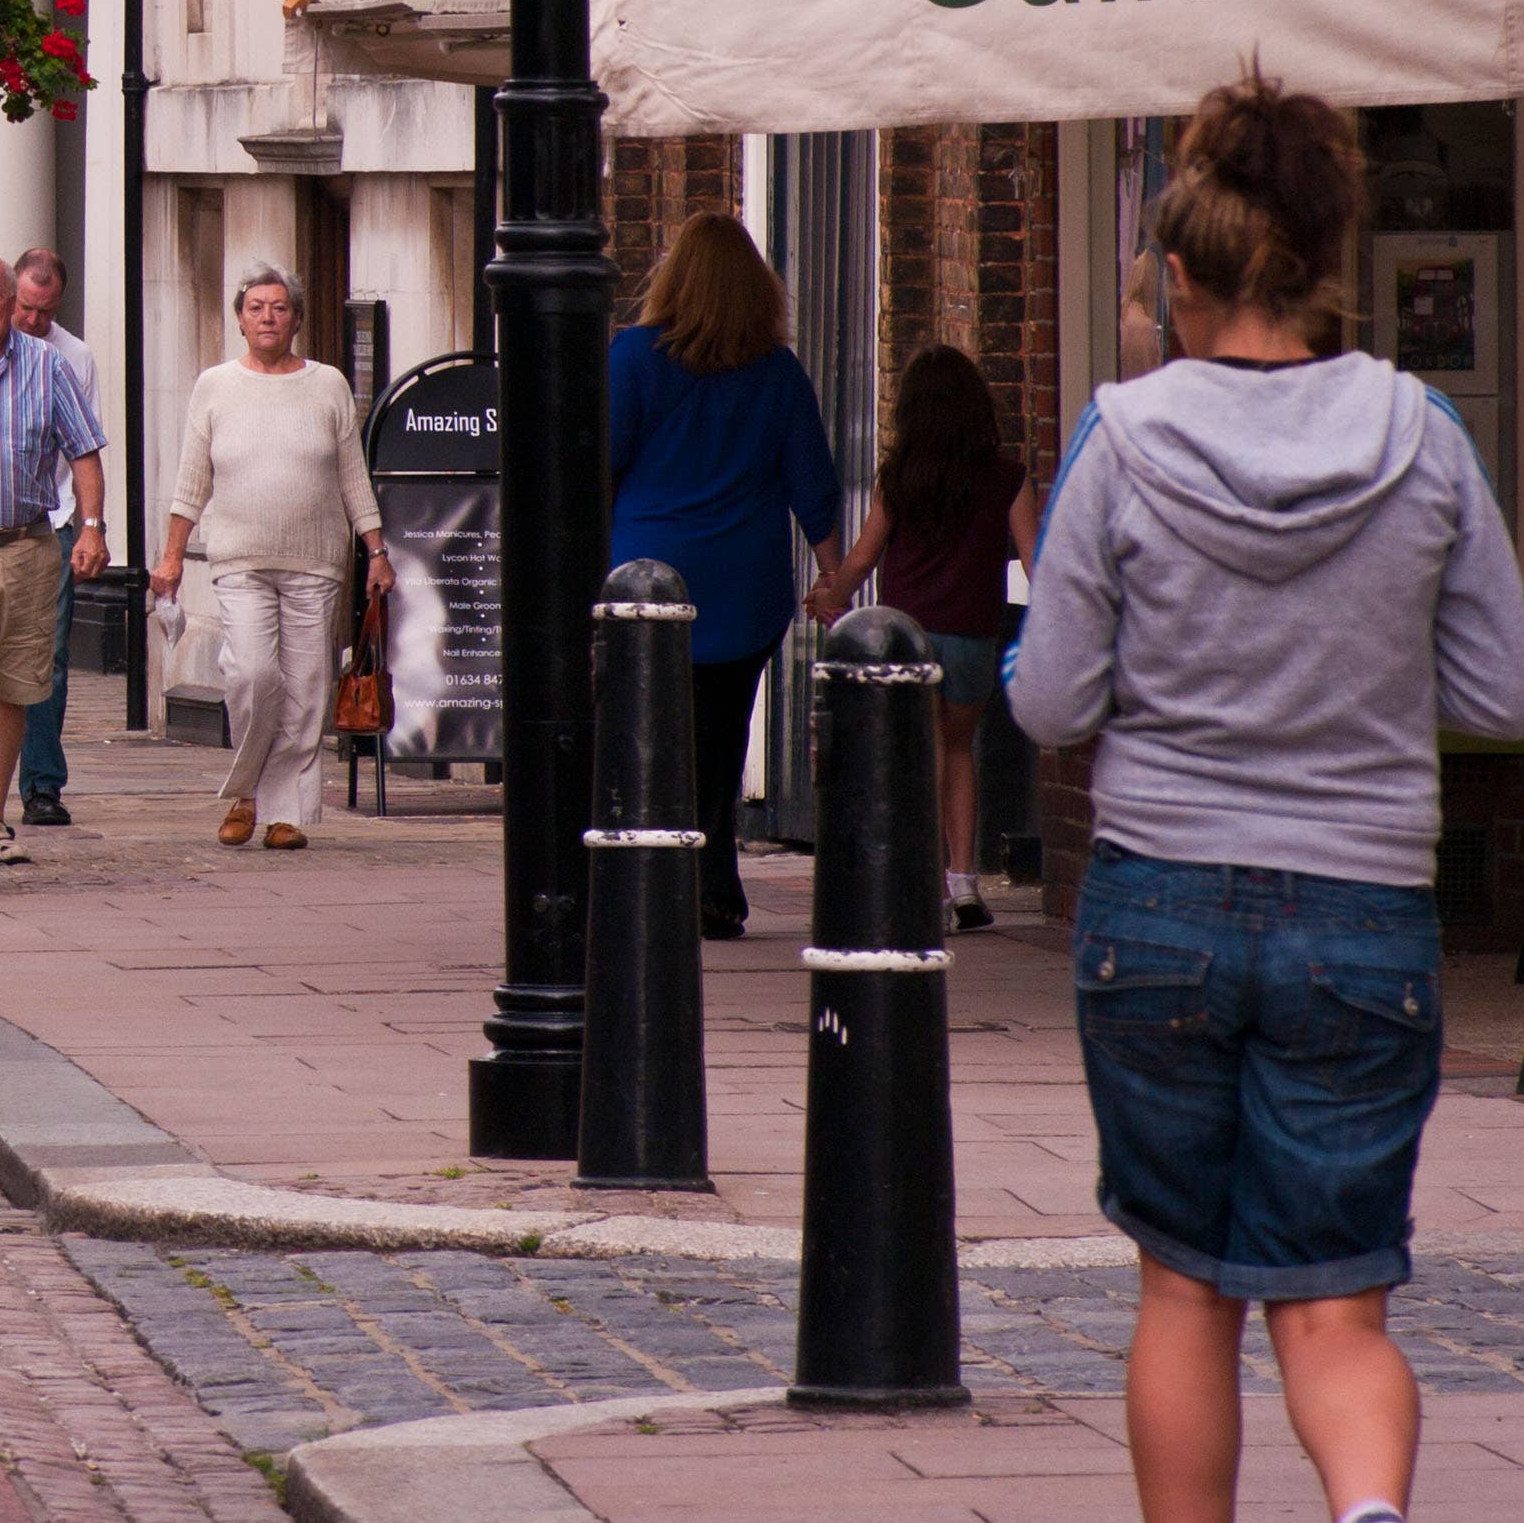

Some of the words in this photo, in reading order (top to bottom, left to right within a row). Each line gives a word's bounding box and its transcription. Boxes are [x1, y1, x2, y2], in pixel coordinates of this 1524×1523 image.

[406, 408, 480, 437] Amazing
[403, 530, 434, 538] Jessica
[436, 530, 482, 539] Manicures,
[442, 554, 468, 563] Lycon
[470, 554, 486, 562] Hot
[461, 577, 497, 587] Organic
[449, 601, 471, 609] Male
[443, 649, 460, 657] Nail
[445, 674, 481, 686] 01634
